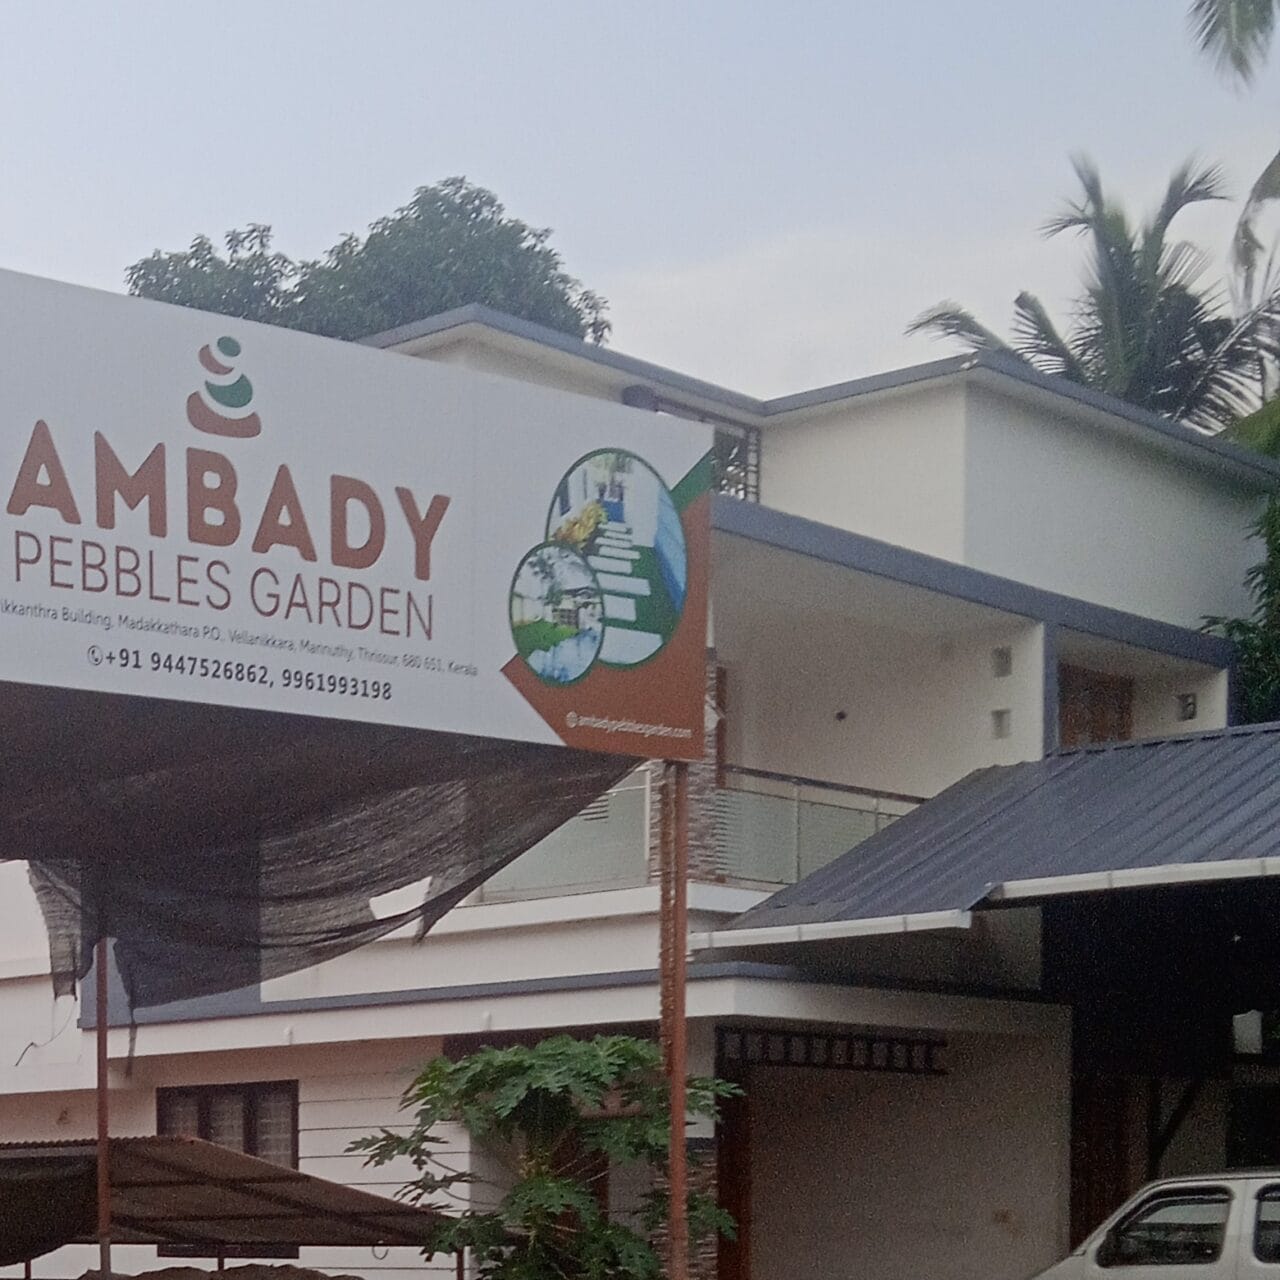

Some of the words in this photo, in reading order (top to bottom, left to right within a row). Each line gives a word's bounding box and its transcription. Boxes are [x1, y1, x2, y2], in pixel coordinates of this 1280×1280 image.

[7, 419, 452, 581] AMBADY
[14, 529, 232, 611] PEBBLES
[250, 566, 434, 640] GARDEN
[105, 648, 143, 669] +91
[151, 652, 275, 688] 9447526862,
[282, 668, 392, 700] 9961993198
